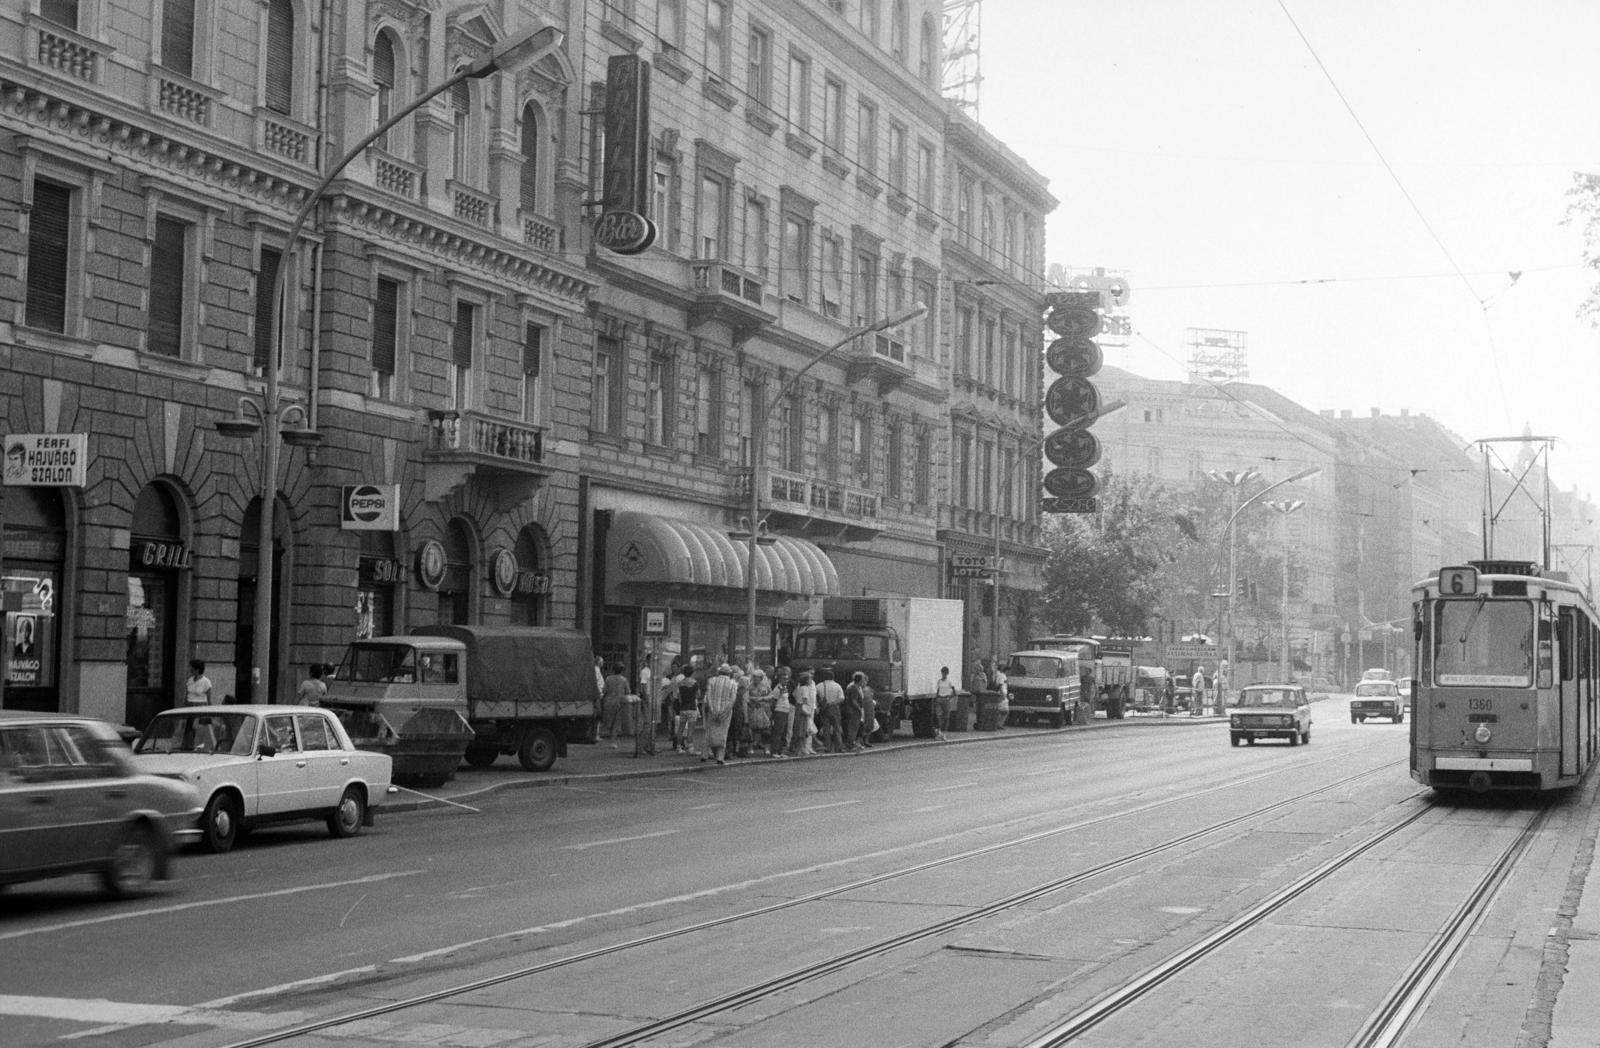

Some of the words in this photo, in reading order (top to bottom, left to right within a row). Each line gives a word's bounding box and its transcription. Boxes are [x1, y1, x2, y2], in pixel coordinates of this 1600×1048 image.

[37, 437, 69, 449] FÉRFI
[28, 449, 76, 466] HAJVÁGÓ
[31, 467, 72, 483] SZALON
[351, 498, 385, 509] PEPSI
[142, 542, 190, 568] GRILL
[1451, 573, 1464, 594] 6
[1469, 698, 1492, 711] 1360
